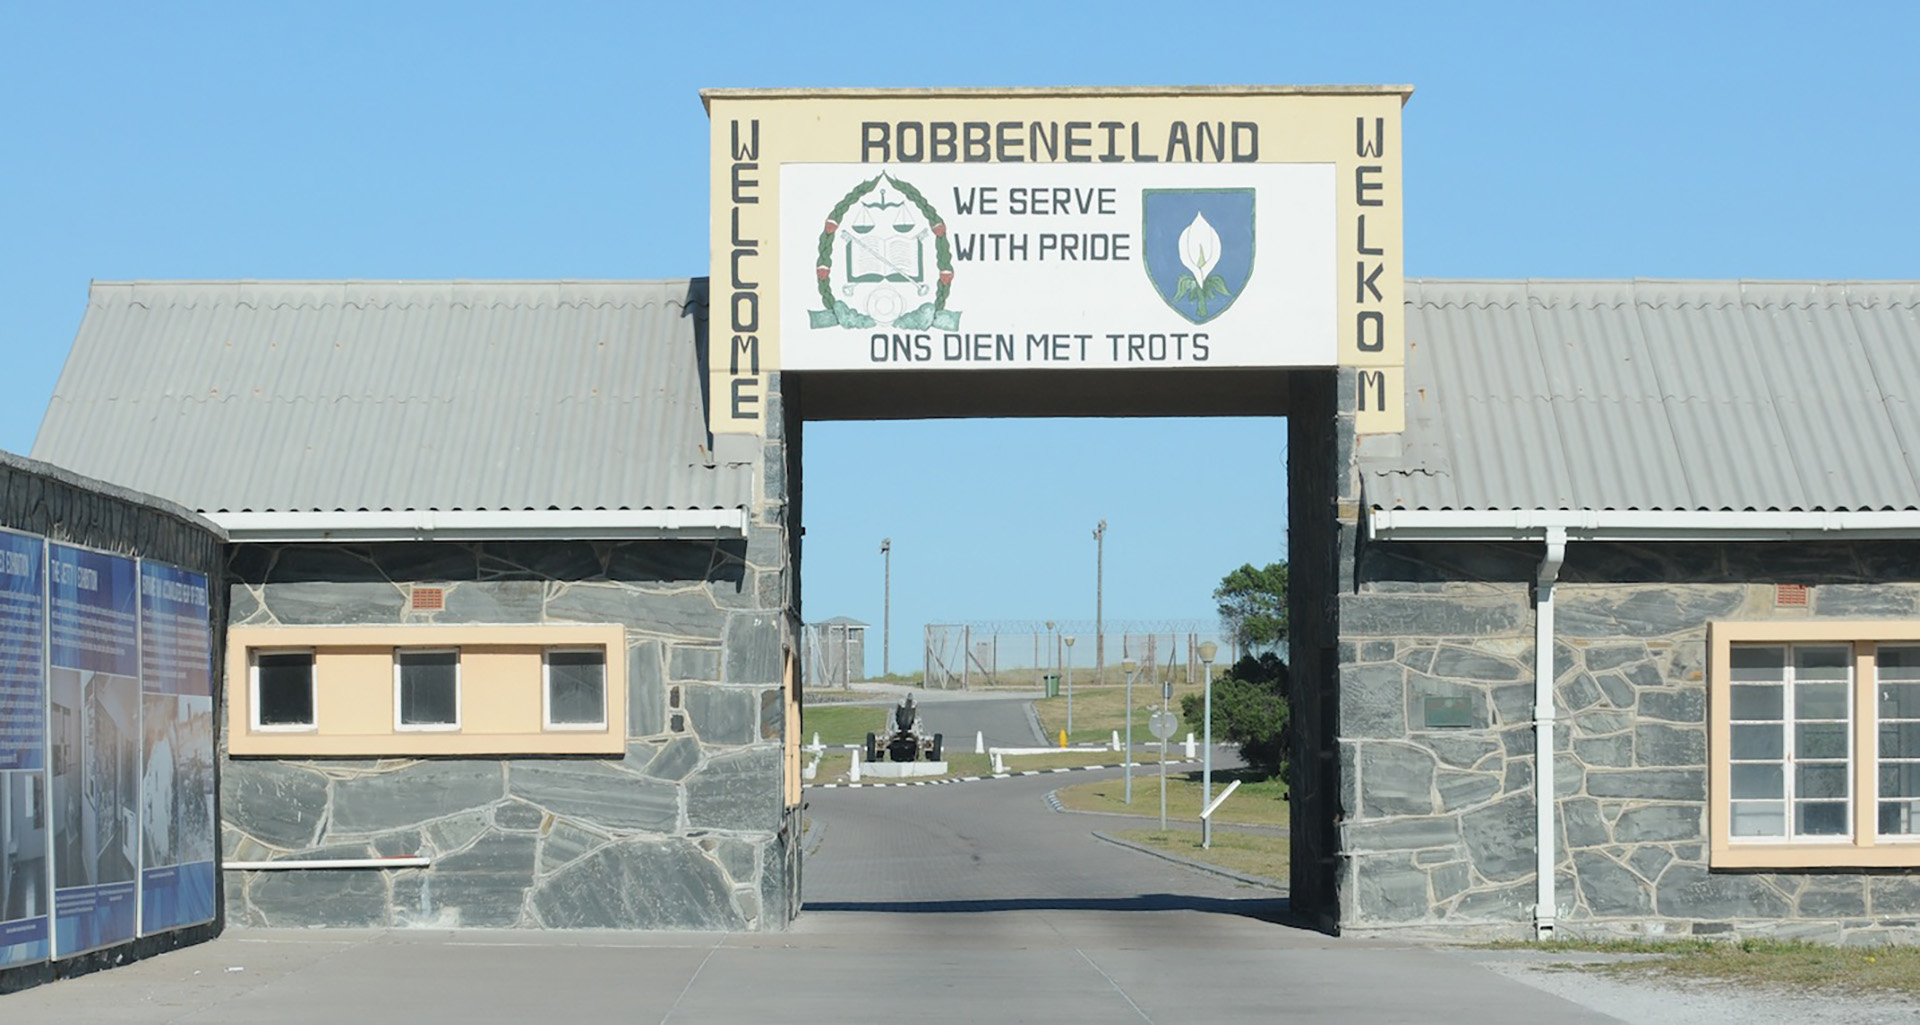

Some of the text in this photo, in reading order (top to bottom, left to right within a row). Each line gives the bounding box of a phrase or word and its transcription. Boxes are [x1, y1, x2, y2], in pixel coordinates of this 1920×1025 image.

[862, 121, 1258, 161] ROBBENEILAND
[954, 187, 1115, 214] WE SERVE
[955, 234, 1129, 261] WITH PRIDE
[730, 120, 759, 419] WELCOME
[1355, 118, 1385, 411] WELKOM
[871, 334, 1208, 361] ONS DIEN MET TROTS
